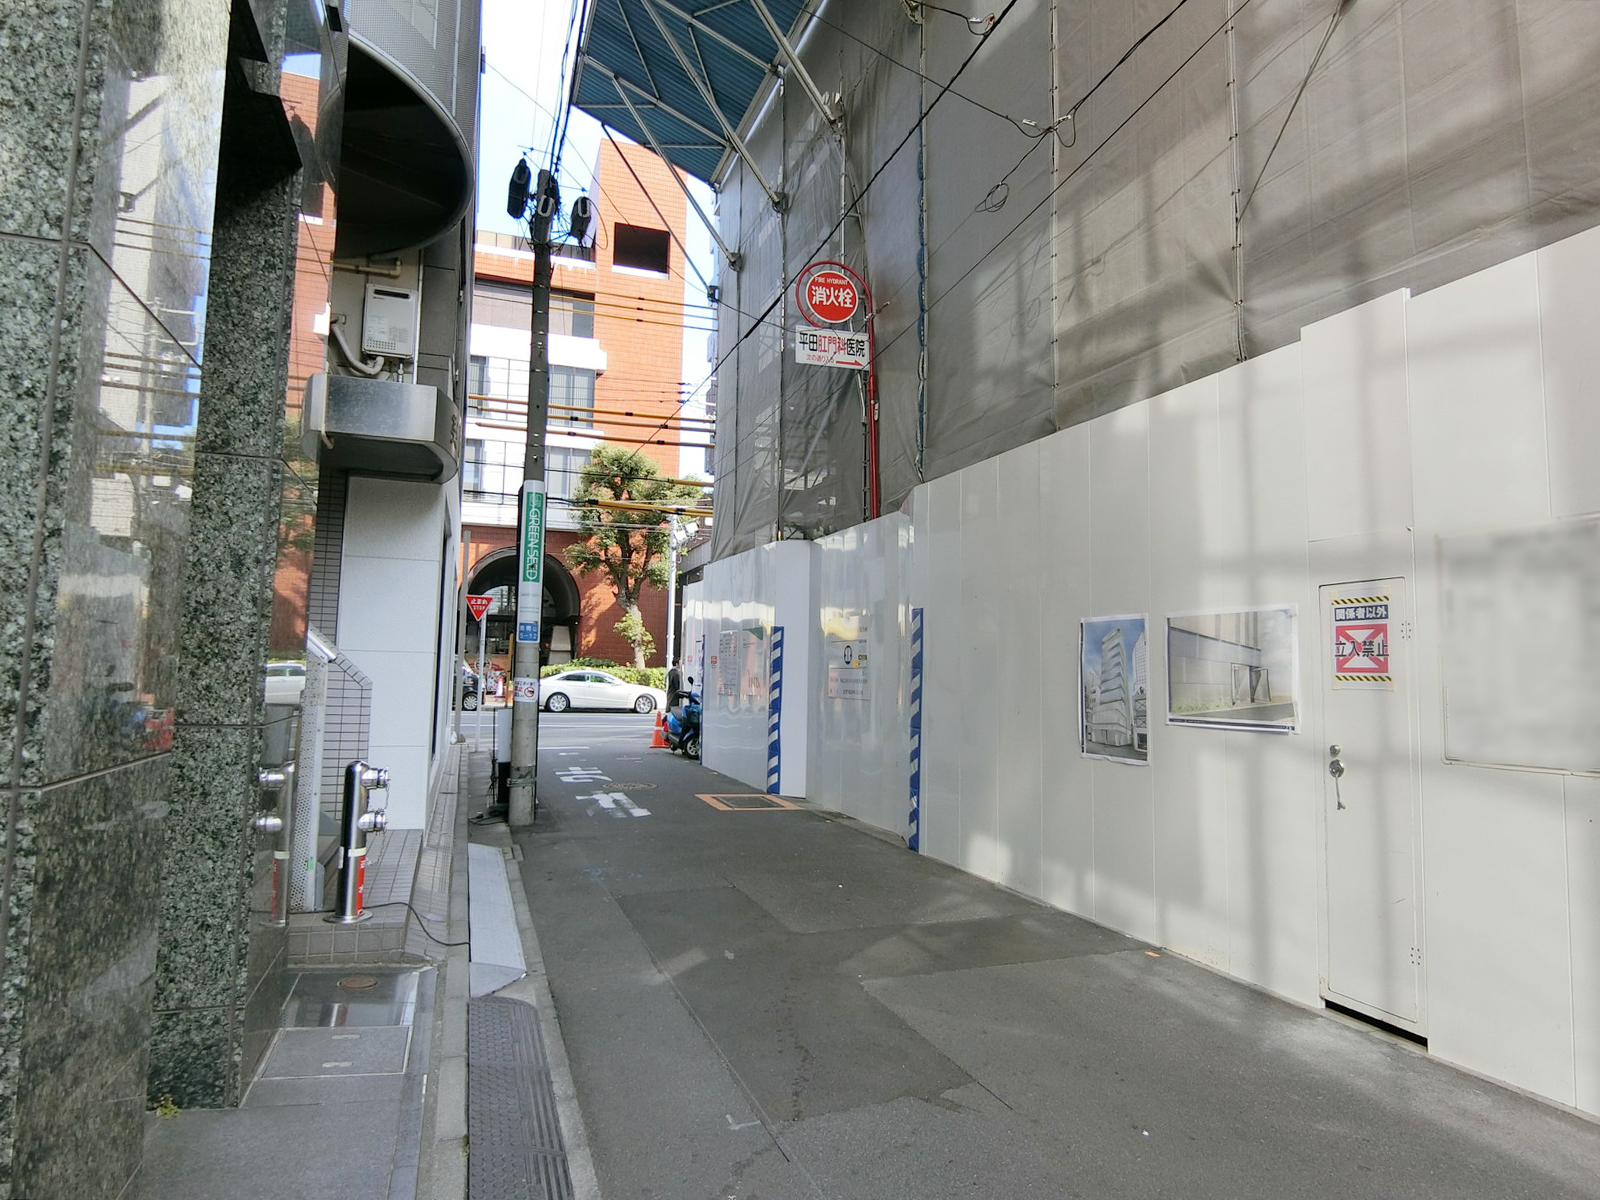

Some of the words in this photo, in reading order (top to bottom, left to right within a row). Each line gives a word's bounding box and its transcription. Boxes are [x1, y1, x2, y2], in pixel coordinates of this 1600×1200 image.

[811, 285, 853, 307] 消火栓
[799, 332, 865, 357] 平田肛門科医院
[528, 508, 540, 548] GREEN
[526, 549, 539, 580] SEED
[1335, 606, 1387, 620] 関係者以外
[1335, 640, 1389, 657] 立入禁止
